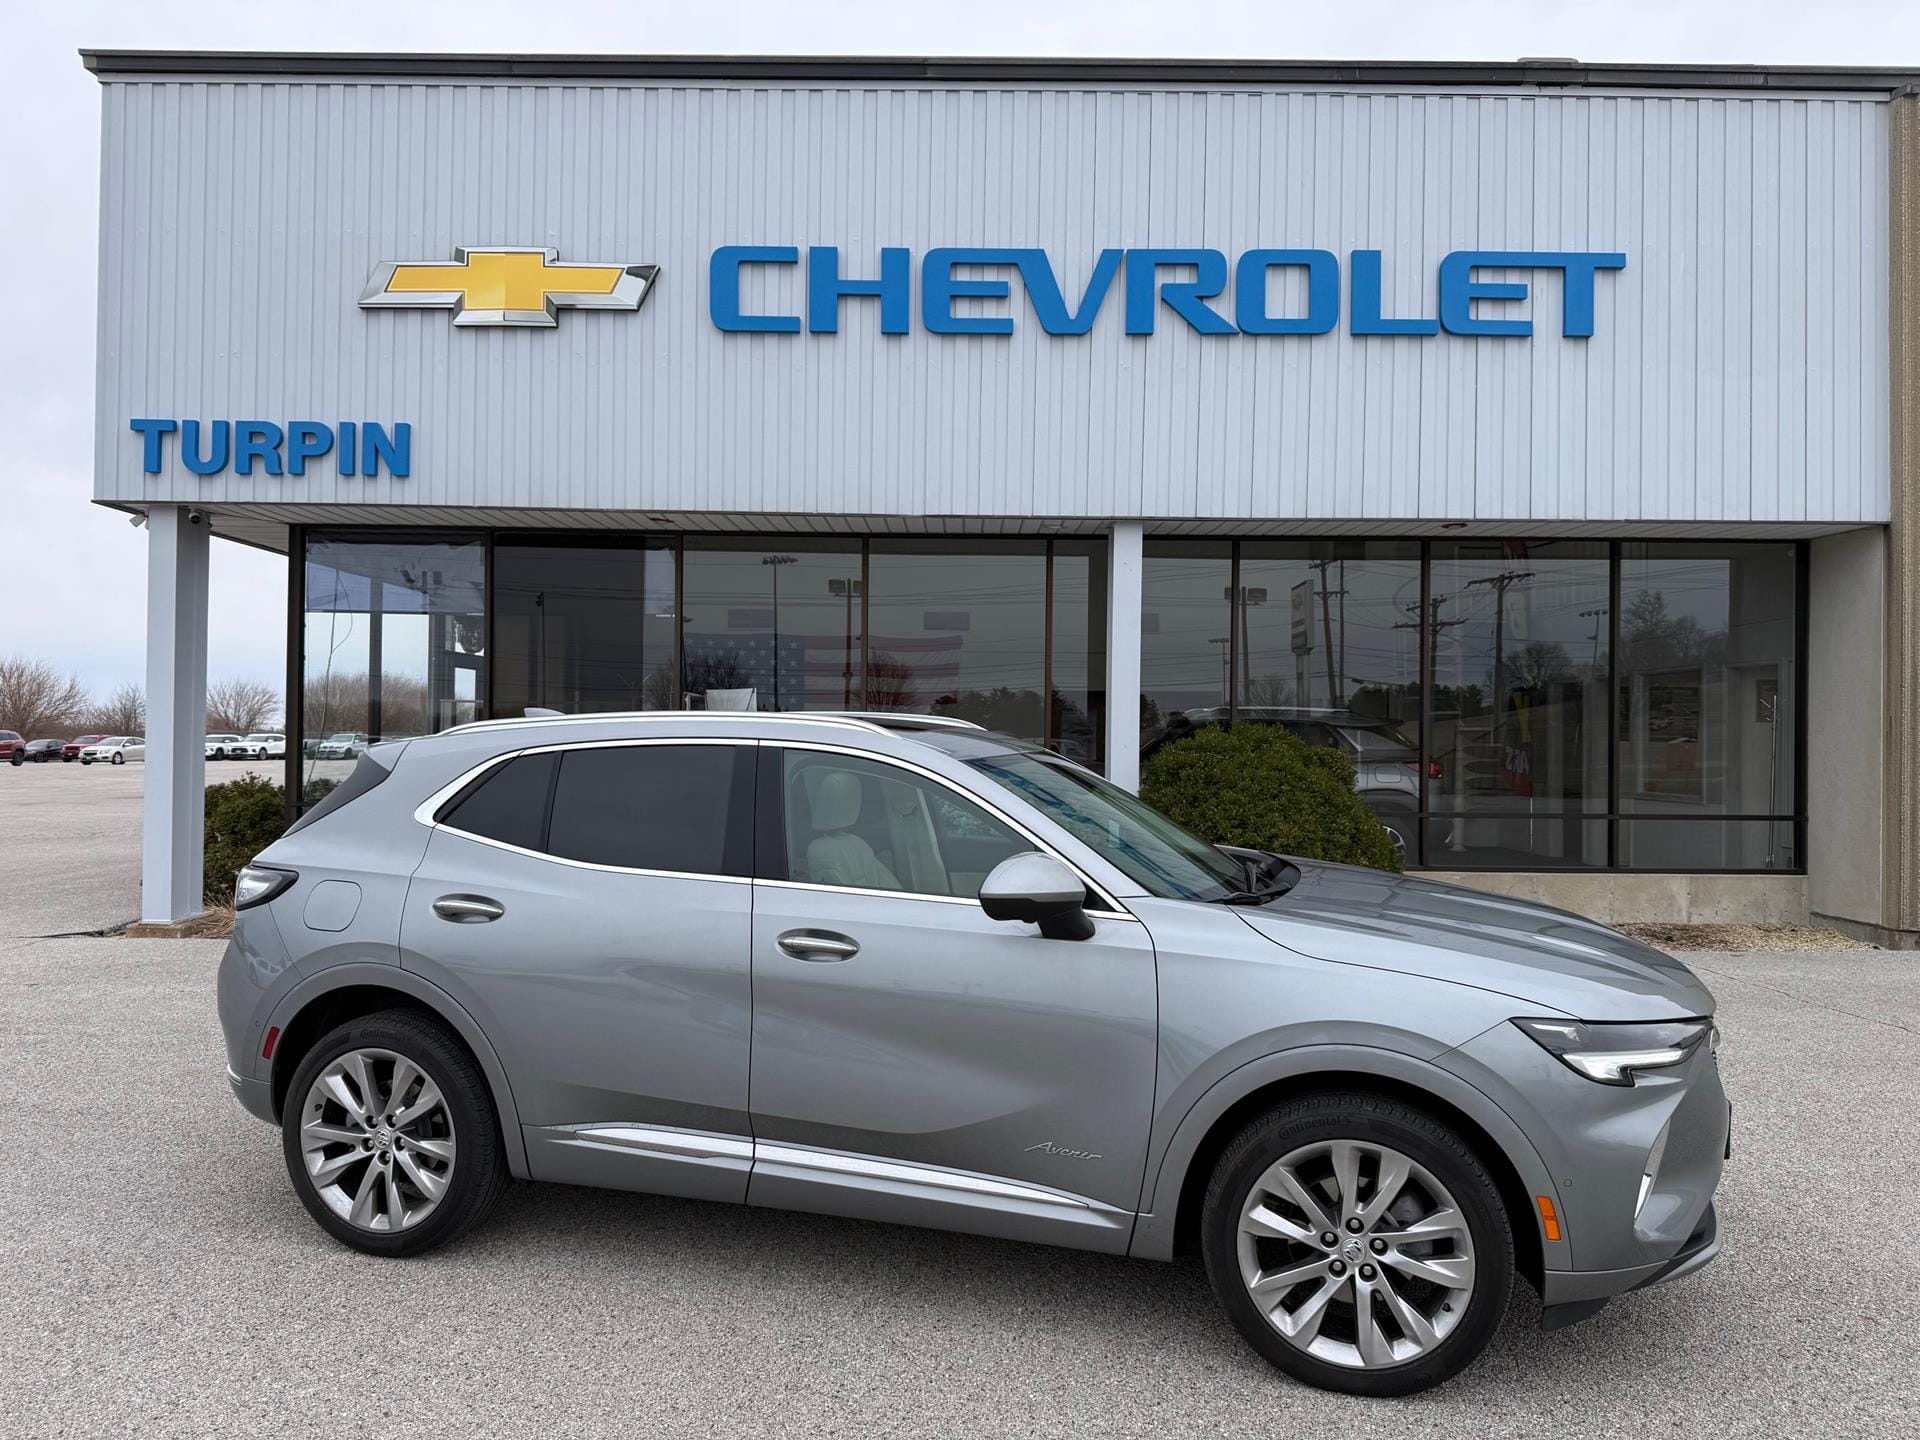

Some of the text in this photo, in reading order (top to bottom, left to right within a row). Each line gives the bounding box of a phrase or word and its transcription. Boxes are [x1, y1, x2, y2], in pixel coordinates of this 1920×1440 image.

[708, 245, 1627, 337] CHEVROLET
[129, 418, 412, 478] TURPIN
[1023, 1141, 1104, 1161] Avenir
